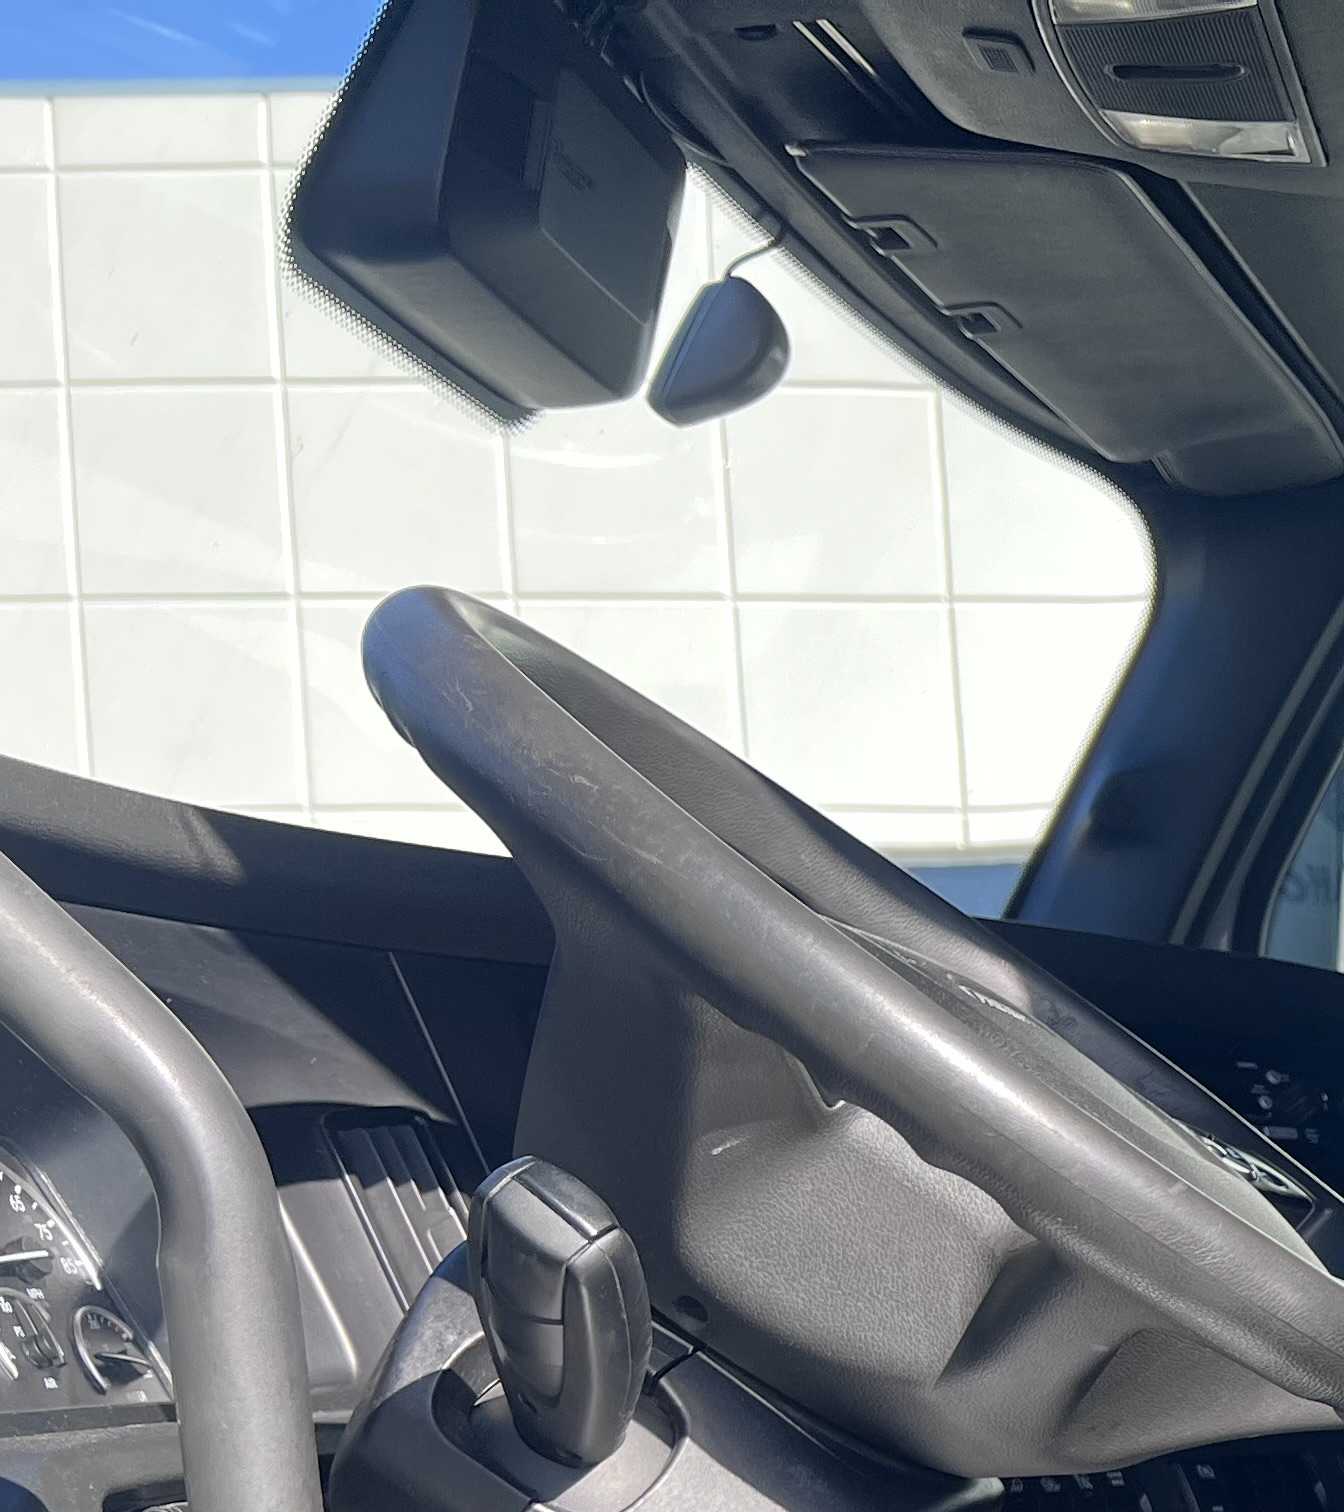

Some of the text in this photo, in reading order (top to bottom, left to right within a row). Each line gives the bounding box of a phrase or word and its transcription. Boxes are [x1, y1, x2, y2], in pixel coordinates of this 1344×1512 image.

[9, 1195, 25, 1212] 65
[34, 1222, 53, 1240] 75
[60, 1256, 78, 1275] 85
